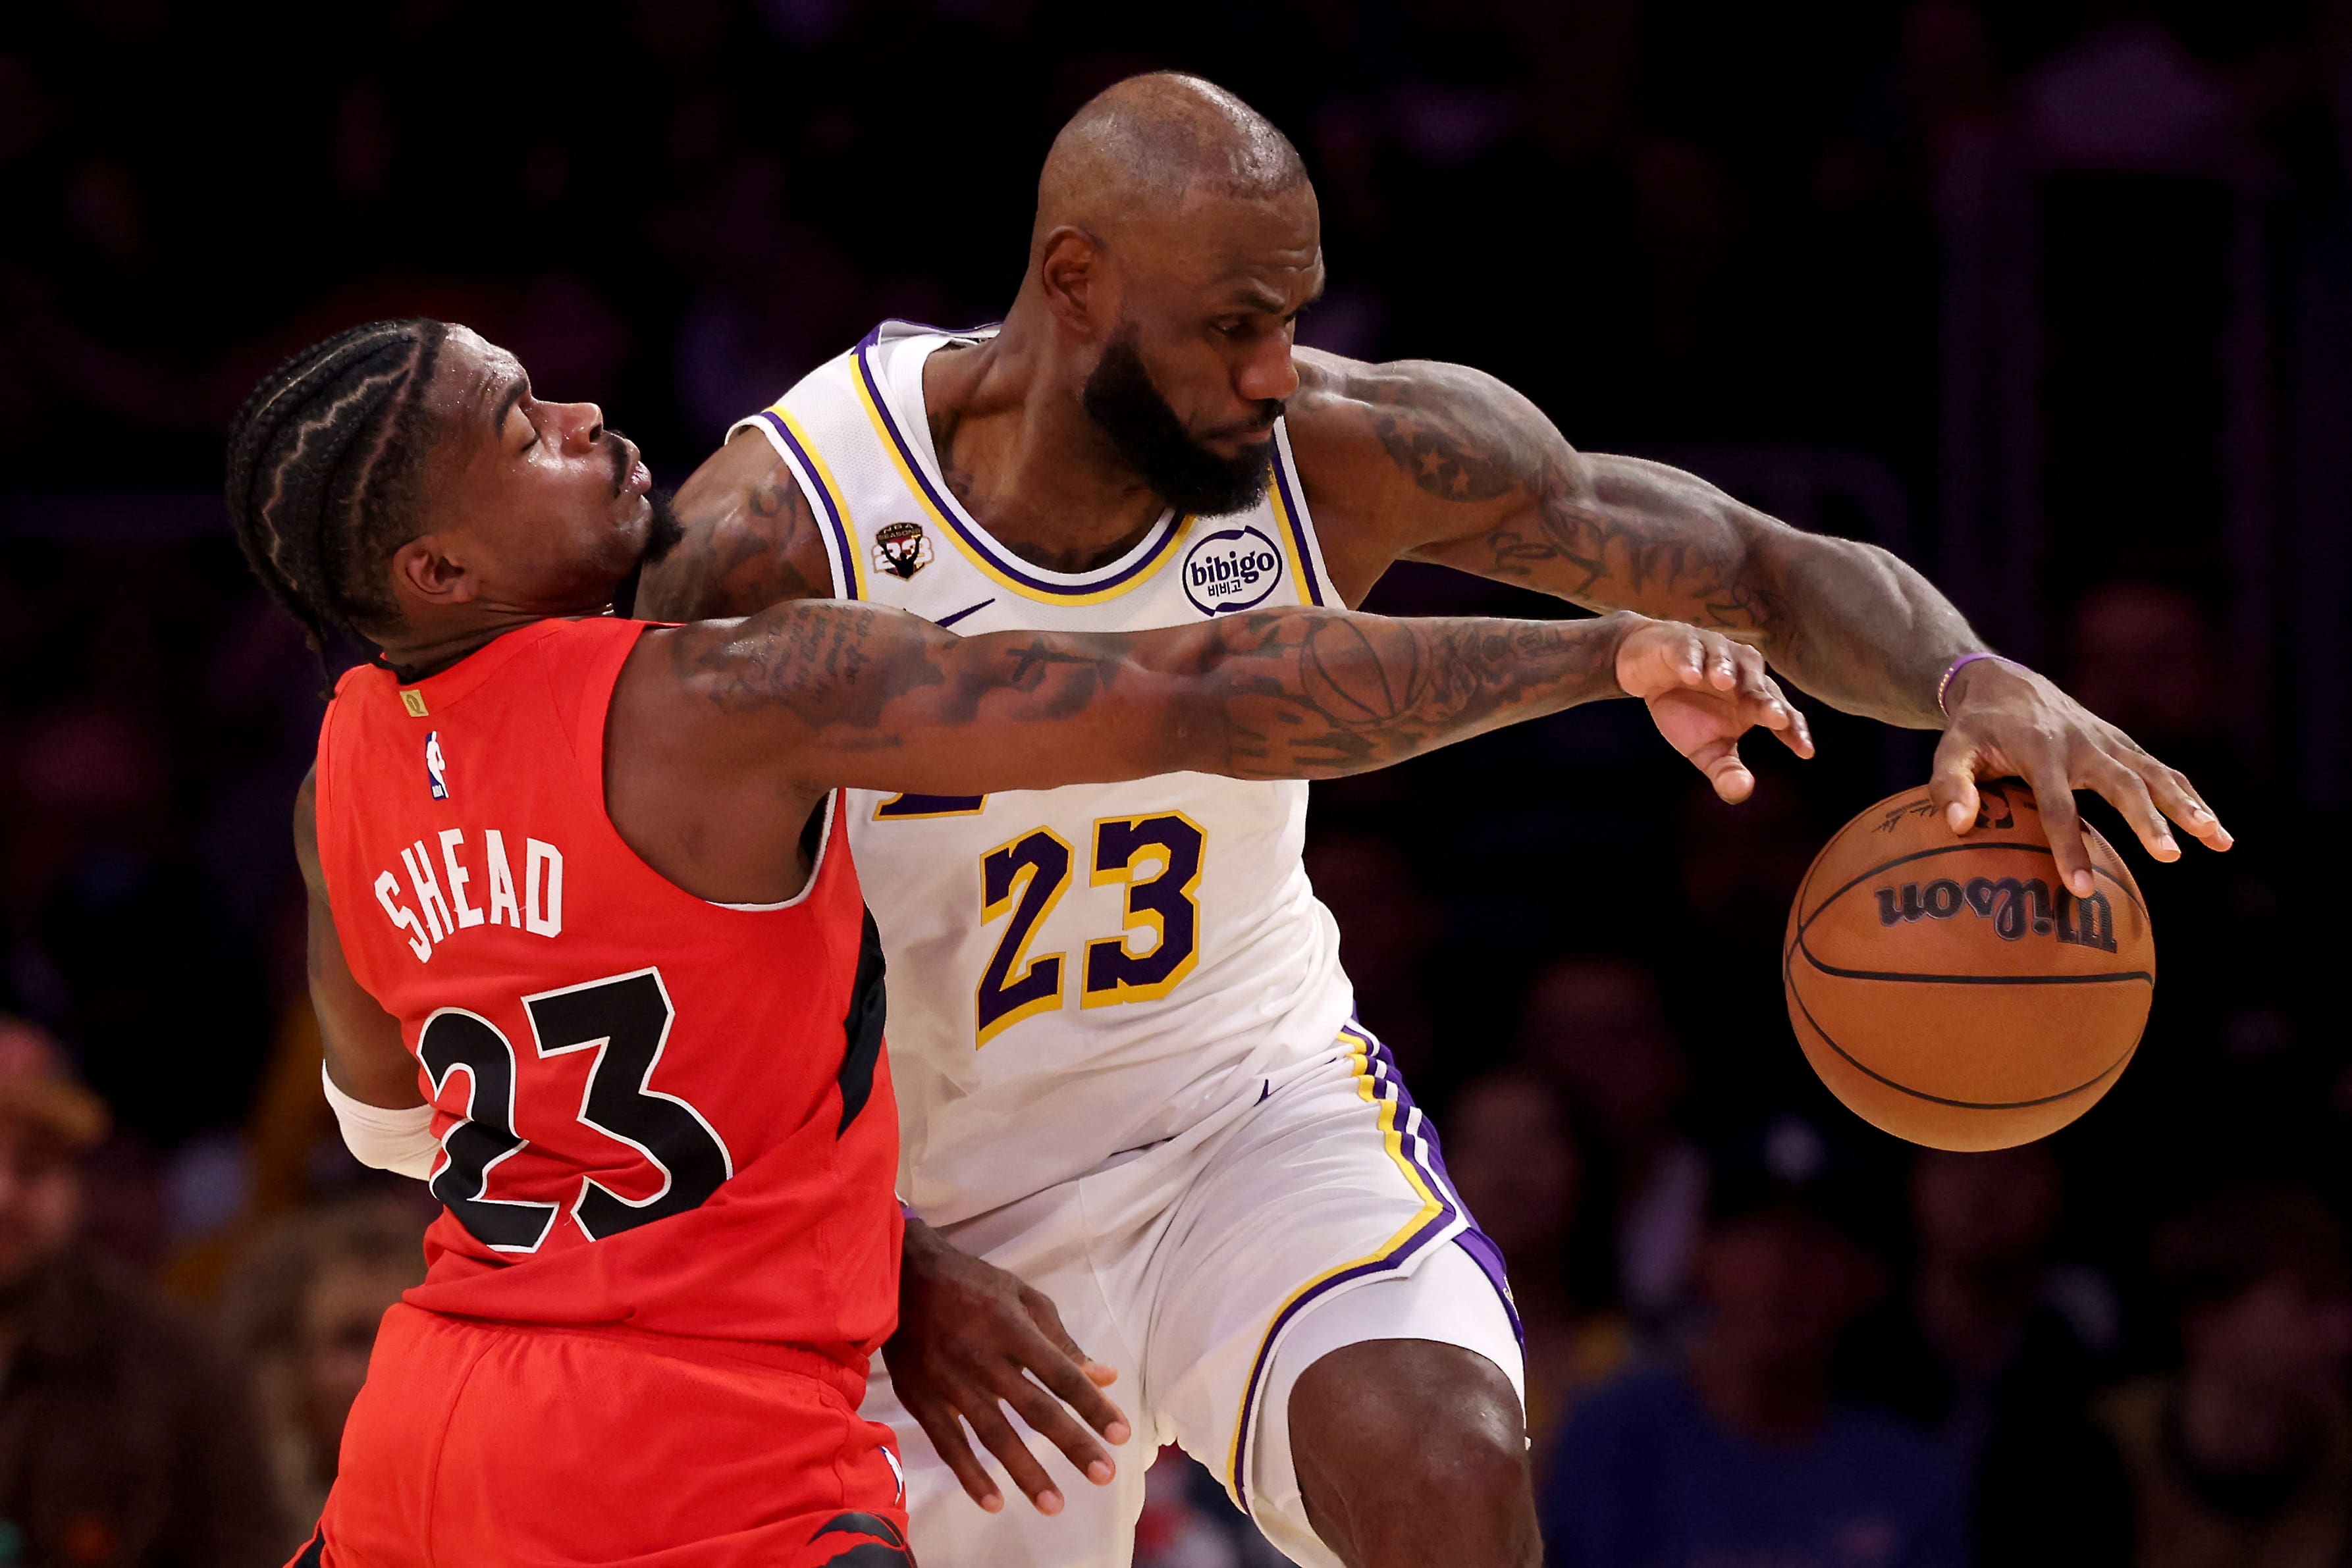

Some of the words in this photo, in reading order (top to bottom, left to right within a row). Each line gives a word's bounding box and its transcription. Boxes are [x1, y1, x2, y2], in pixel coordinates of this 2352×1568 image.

[884, 523, 913, 534] NBA
[1190, 550, 1275, 587] bibigo
[1208, 579, 1243, 597] 비비고
[374, 828, 564, 964] SHEAD
[975, 809, 1208, 1051] 23
[1874, 877, 2118, 954] Wilson
[416, 966, 734, 1253] 23
